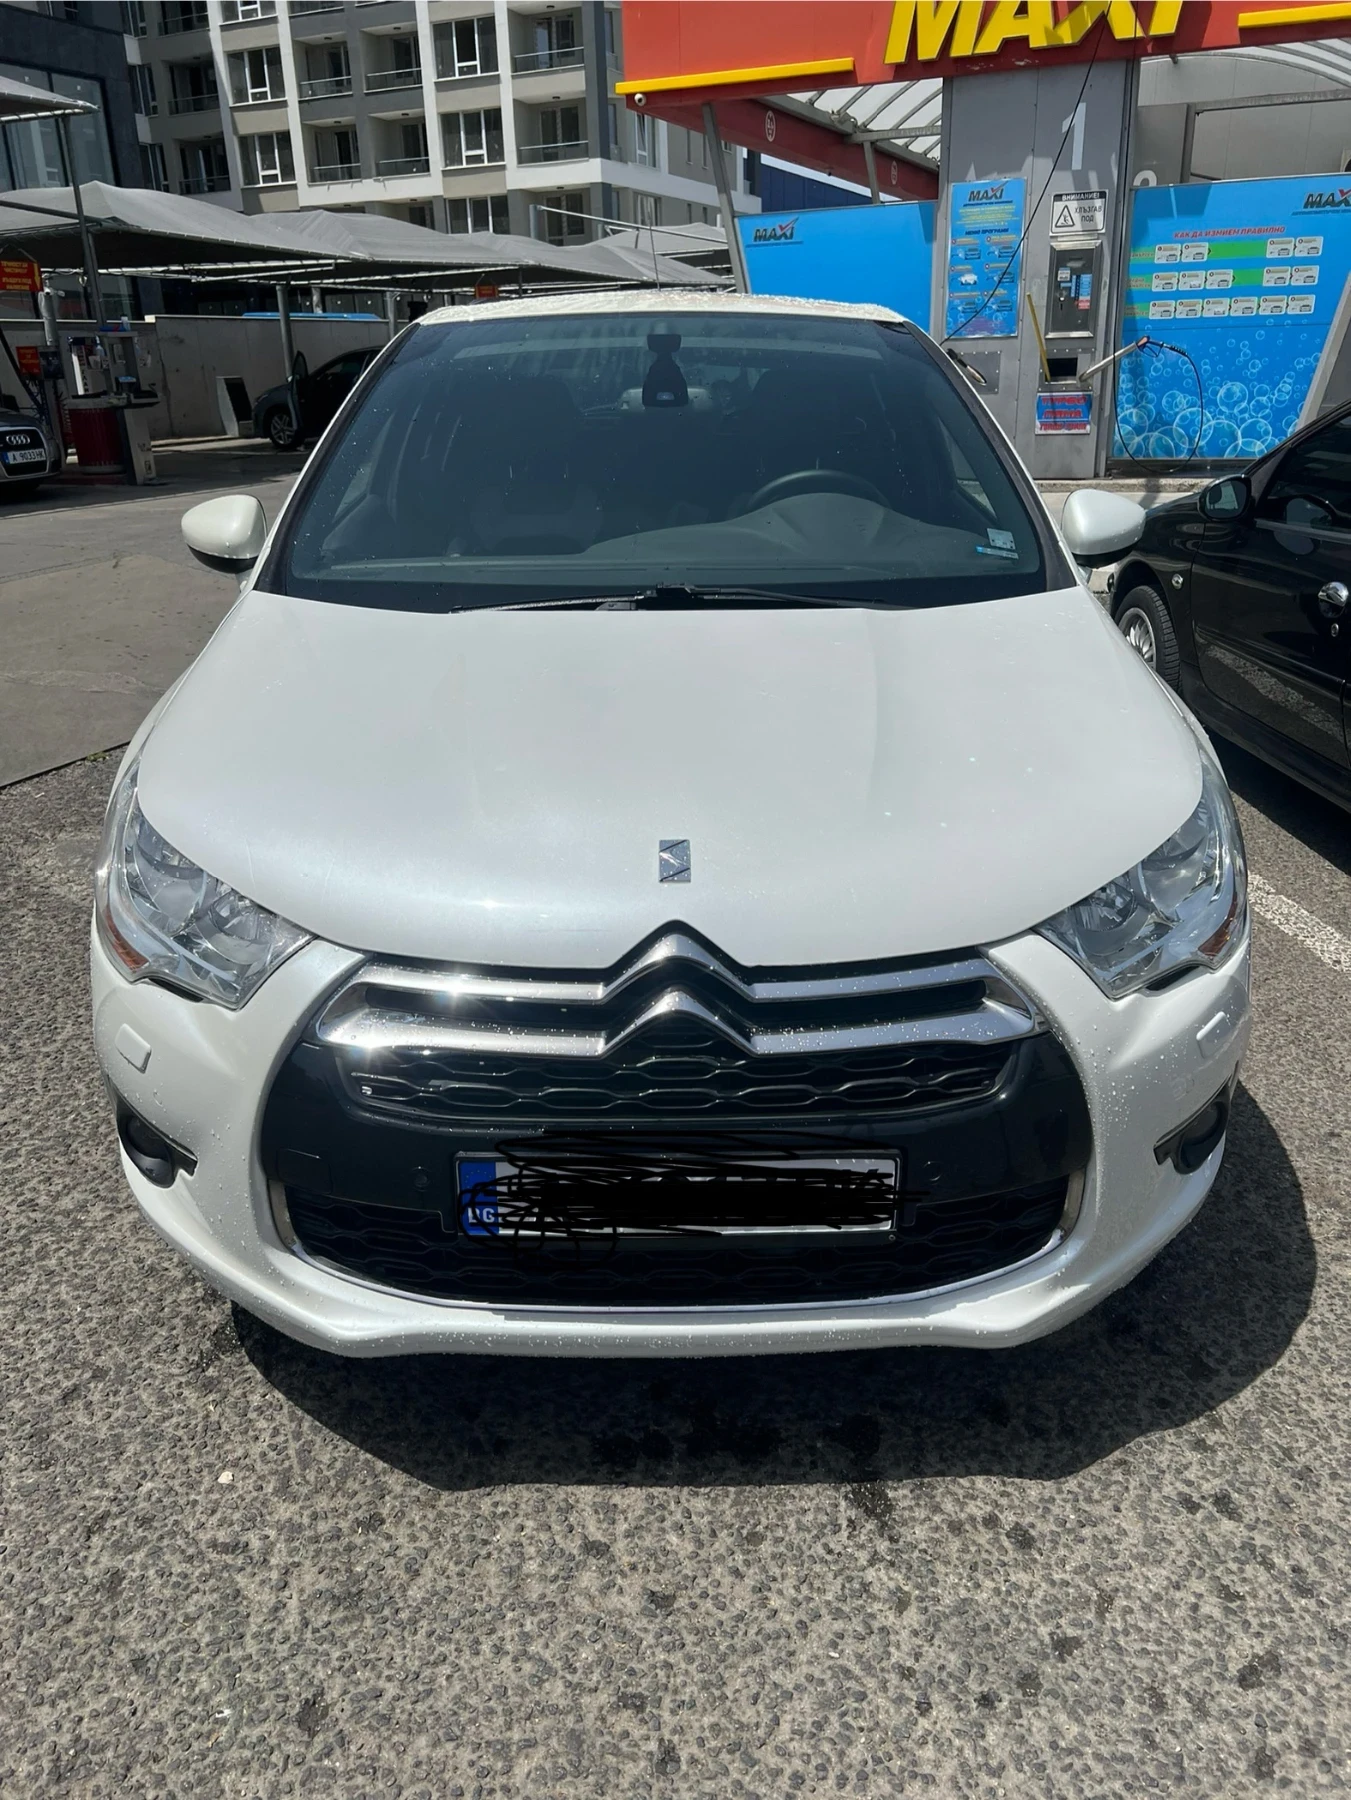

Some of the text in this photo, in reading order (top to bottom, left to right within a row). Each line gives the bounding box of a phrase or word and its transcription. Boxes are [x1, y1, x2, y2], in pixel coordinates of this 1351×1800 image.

[1061, 102, 1087, 171] 1
[968, 187, 1004, 202] MAXI
[1062, 192, 1100, 201] ВНИМАНИЕ!
[1303, 191, 1351, 208] MAX
[1075, 205, 1103, 214] ХЛЪЗГАВ
[1081, 215, 1094, 223] ПОД
[753, 224, 797, 242] MAXI
[1191, 231, 1203, 239] ДА
[1204, 228, 1240, 237] ИЗМИЕМ
[1240, 226, 1286, 235] ПРАВИЛНО
